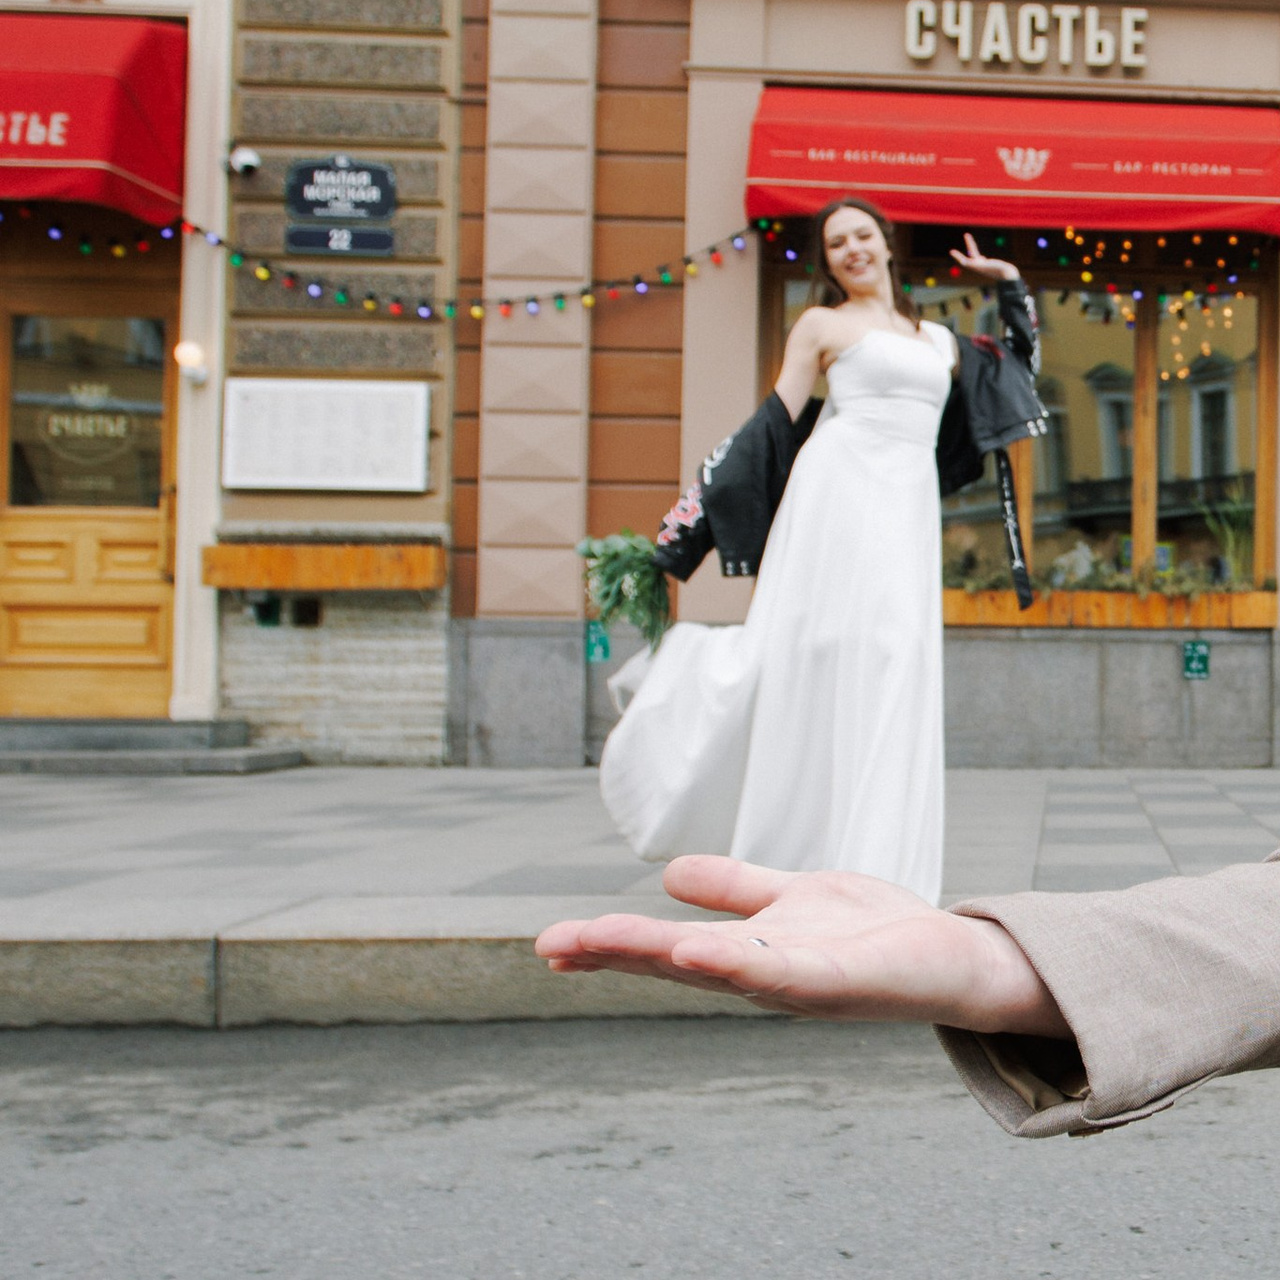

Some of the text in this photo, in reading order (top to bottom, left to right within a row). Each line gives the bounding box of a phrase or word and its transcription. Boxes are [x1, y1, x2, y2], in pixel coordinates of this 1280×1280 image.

[313, 170, 371, 186] МАЛАЯ
[303, 185, 381, 203] МОРСКАЯ
[328, 228, 352, 251] 22
